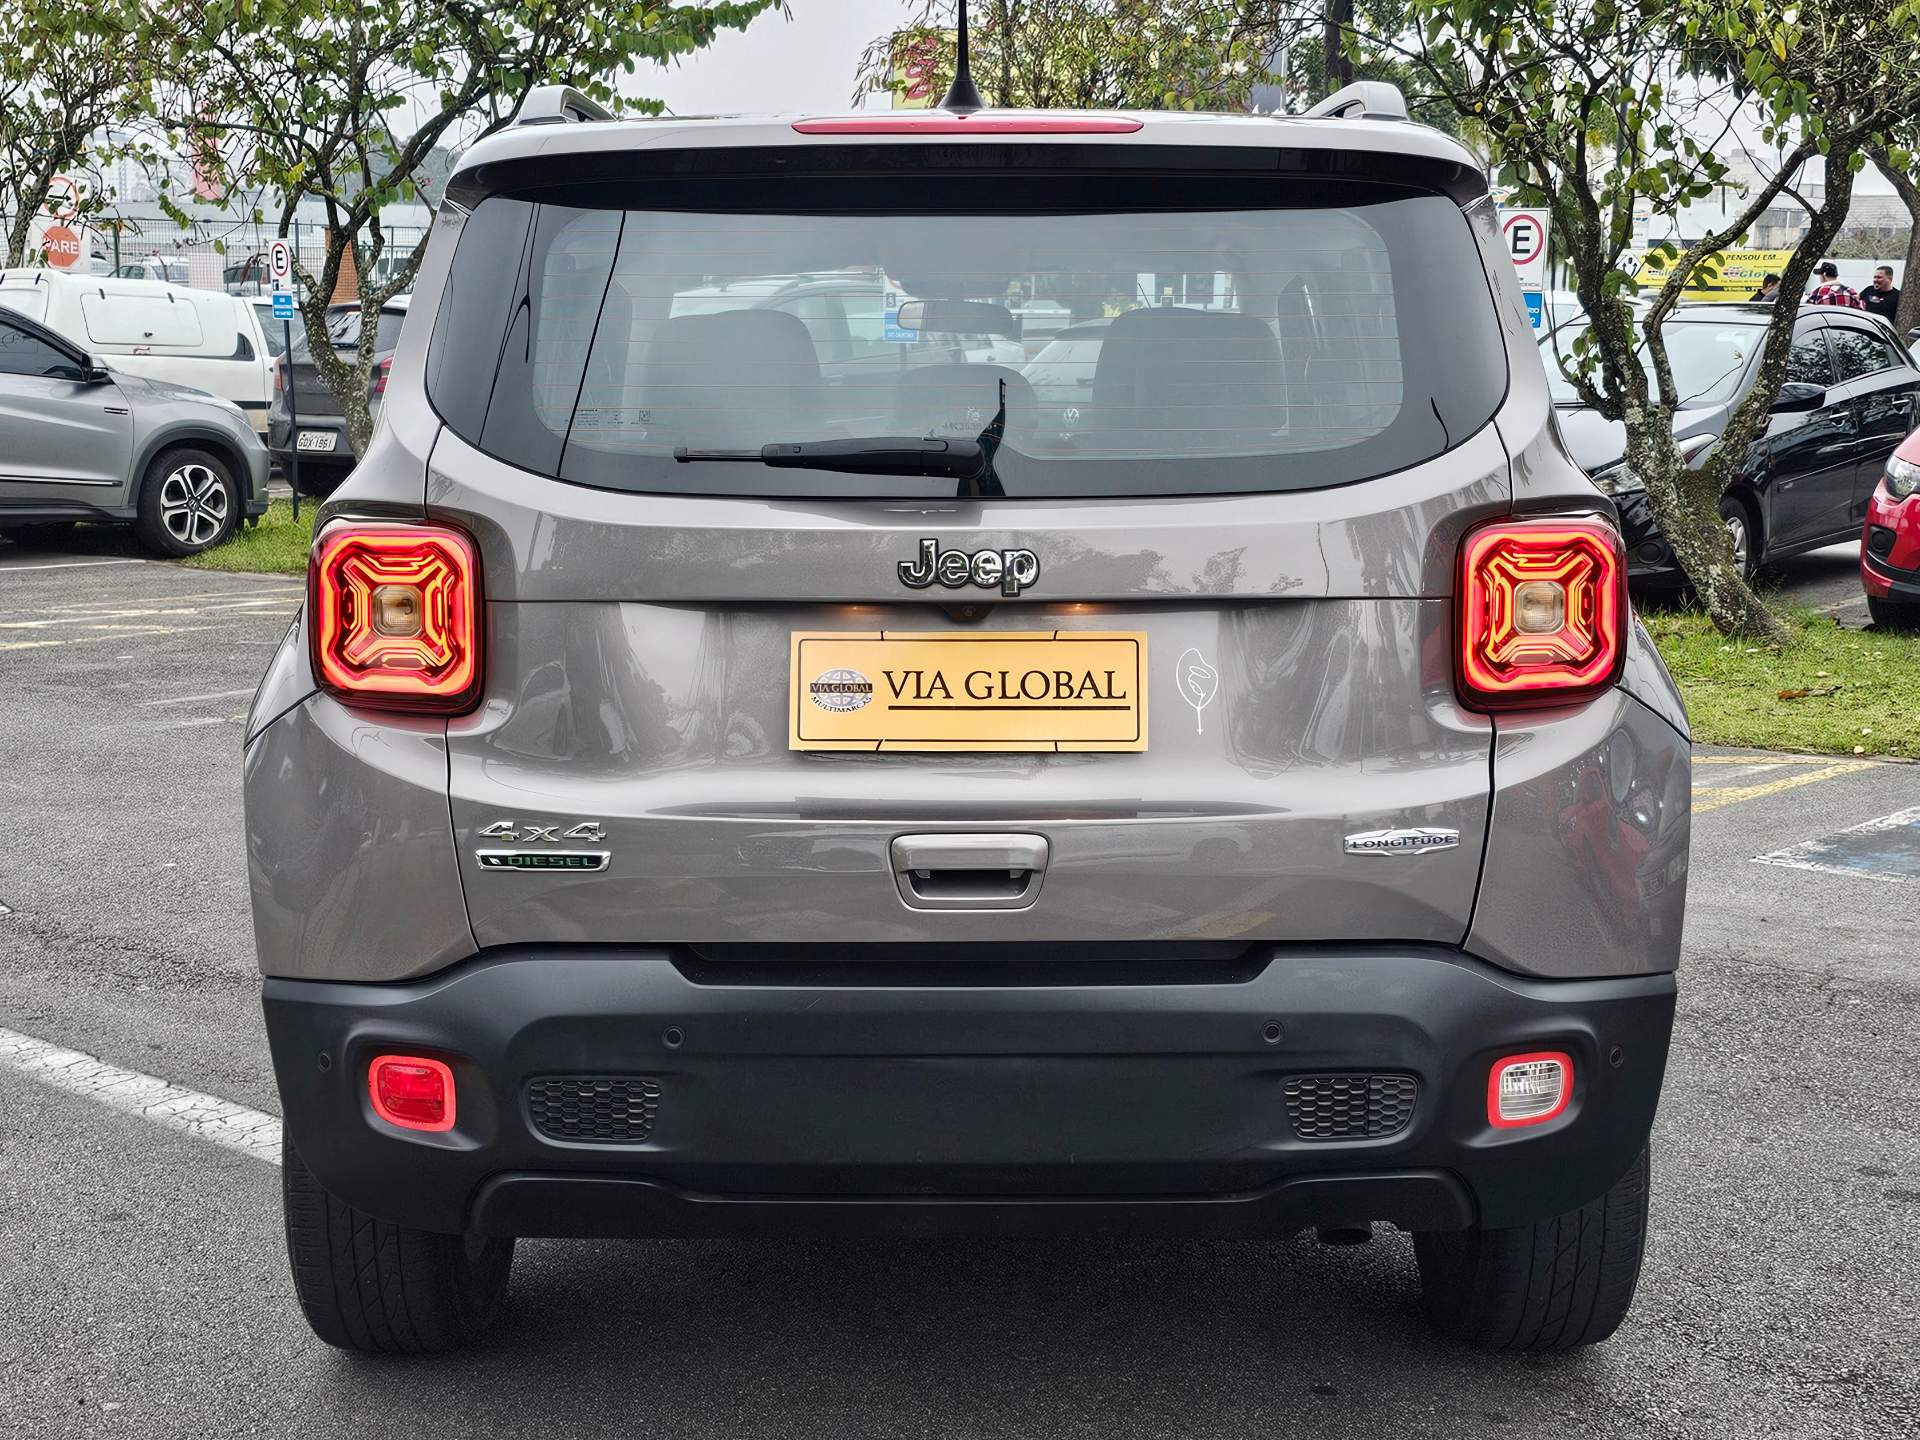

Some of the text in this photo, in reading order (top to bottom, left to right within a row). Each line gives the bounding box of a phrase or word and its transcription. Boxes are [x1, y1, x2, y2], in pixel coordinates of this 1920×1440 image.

[43, 239, 79, 254] PARE
[1512, 225, 1531, 254] E
[275, 250, 283, 269] E
[898, 538, 1040, 597] Jeep
[811, 684, 872, 692] VIA GLOBAL
[882, 670, 1127, 700] VIA GLOBAL
[811, 696, 872, 712] MULTIMARCAS
[478, 821, 607, 841] 4x4
[1352, 835, 1458, 849] LONGITUDE
[507, 856, 597, 866] DIESEL
